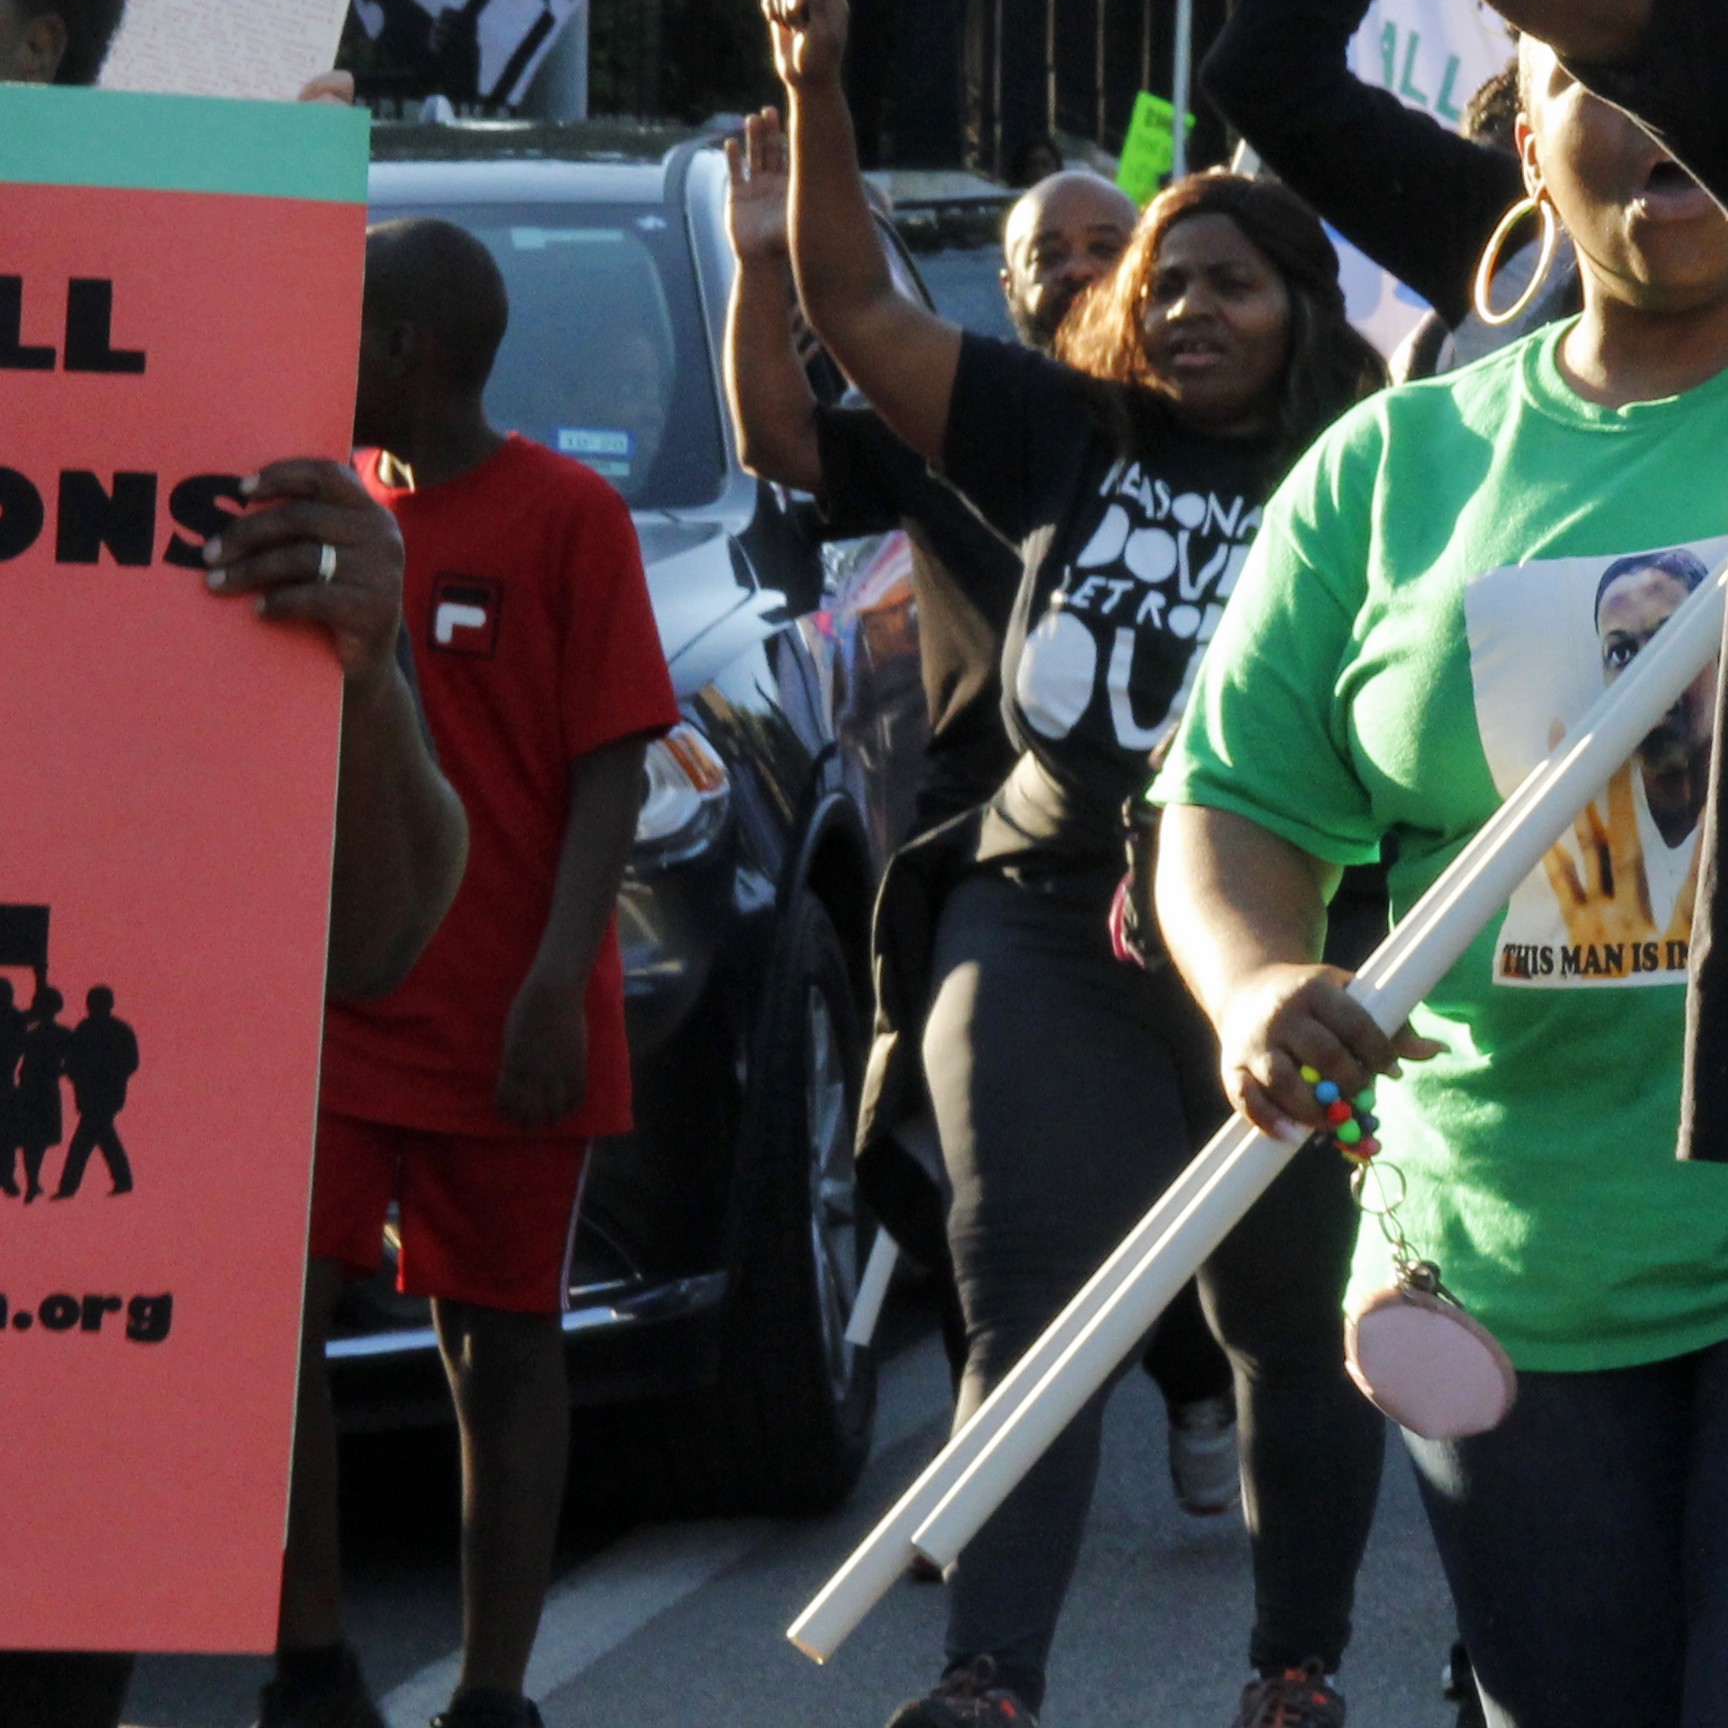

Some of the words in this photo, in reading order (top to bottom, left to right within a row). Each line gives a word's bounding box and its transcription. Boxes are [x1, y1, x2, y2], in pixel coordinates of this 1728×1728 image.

[1380, 18, 1462, 122] ALL
[1502, 943, 1554, 978] THIS
[1560, 943, 1625, 977] MAN
[1631, 942, 1659, 972] IS
[0, 1290, 174, 1344] .org
